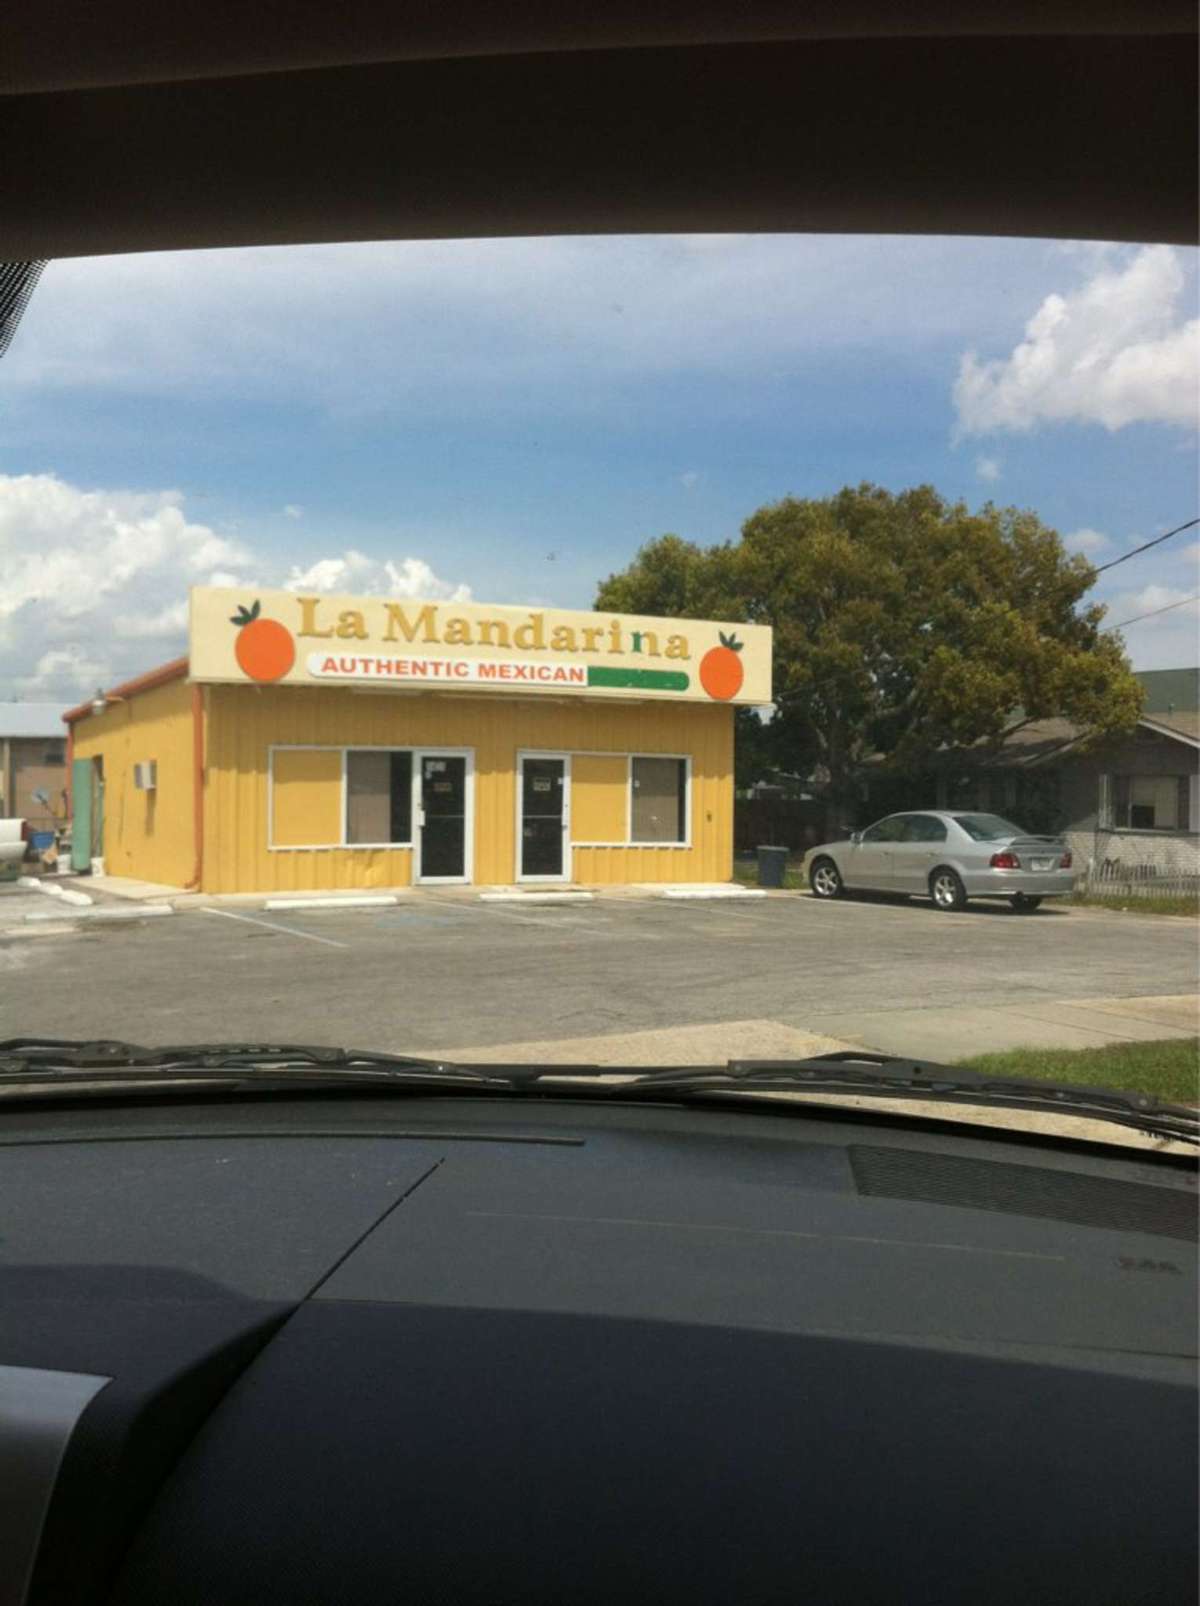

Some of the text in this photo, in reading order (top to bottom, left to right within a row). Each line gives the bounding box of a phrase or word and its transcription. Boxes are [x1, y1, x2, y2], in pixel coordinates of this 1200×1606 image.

[296, 598, 691, 660] La Mandarina
[321, 657, 585, 683] AUTHENTIC MEXICAN
